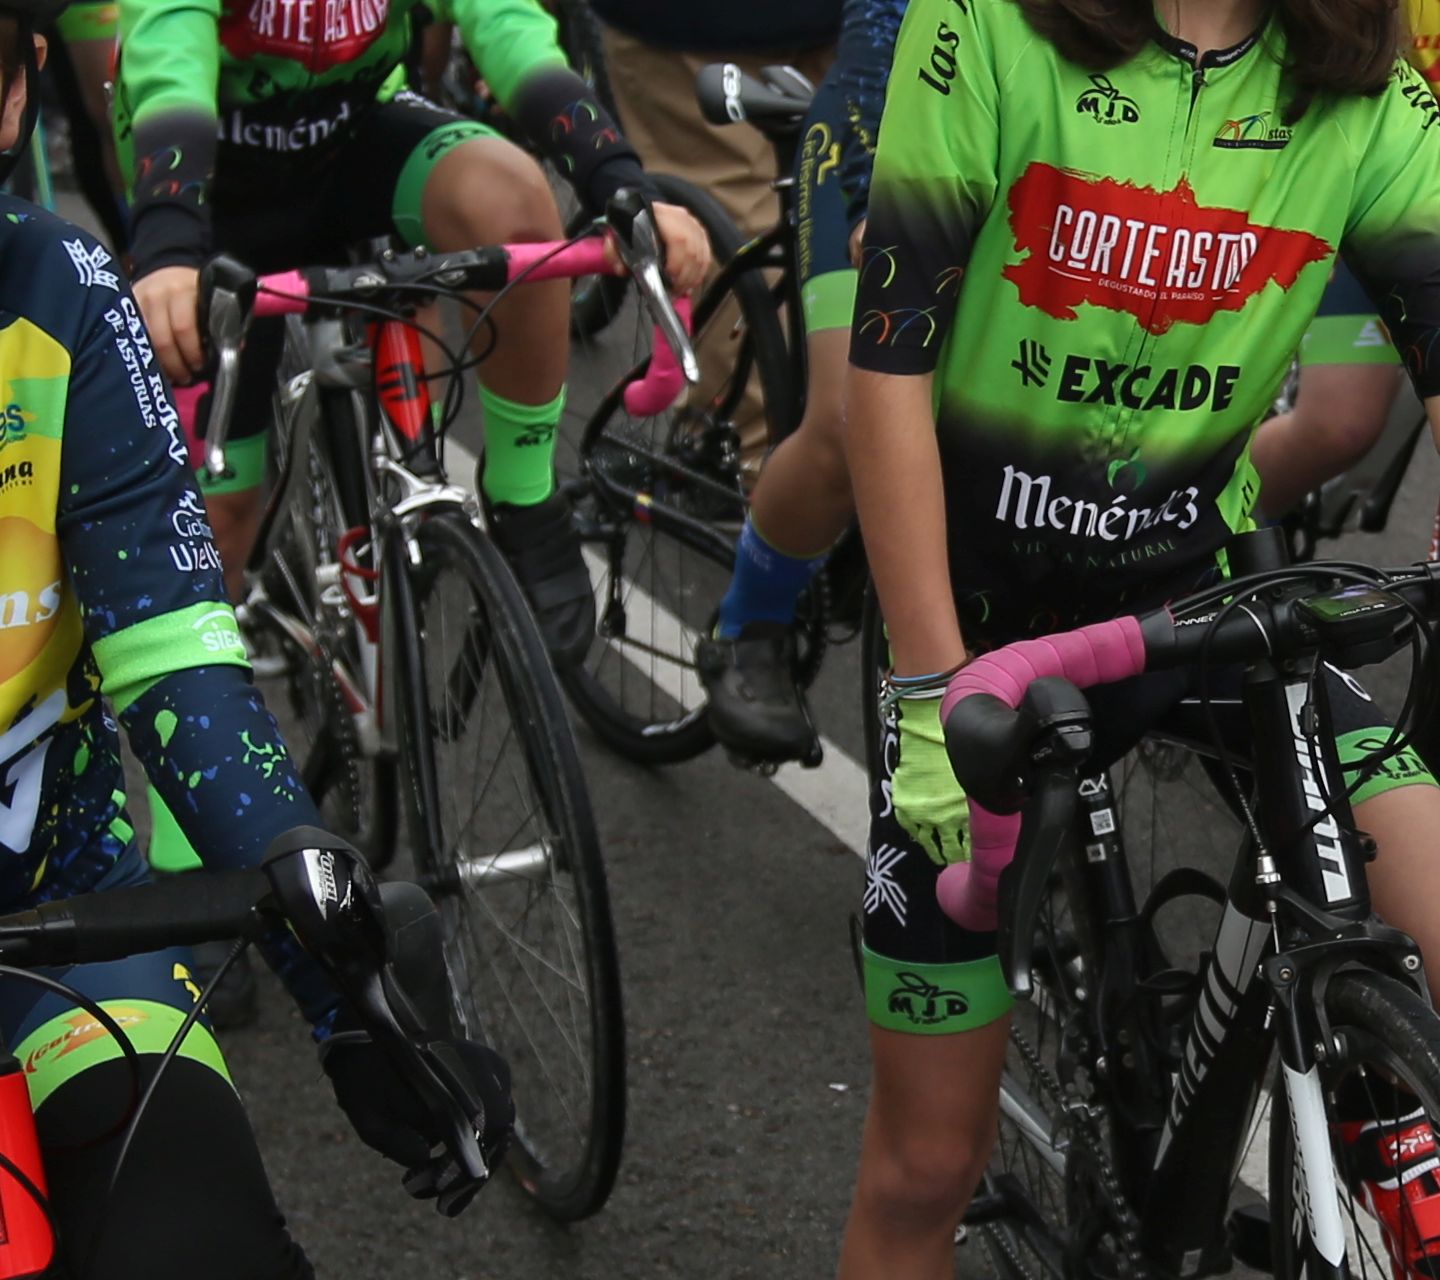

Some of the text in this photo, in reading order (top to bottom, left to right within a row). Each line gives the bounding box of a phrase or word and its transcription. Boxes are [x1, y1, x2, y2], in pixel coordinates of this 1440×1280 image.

[918, 22, 960, 97] las
[104, 307, 158, 429] DE ASTURIAS
[119, 295, 156, 371] CAJA
[1056, 353, 1241, 412] EXCADE
[887, 993, 970, 1017] MJD
